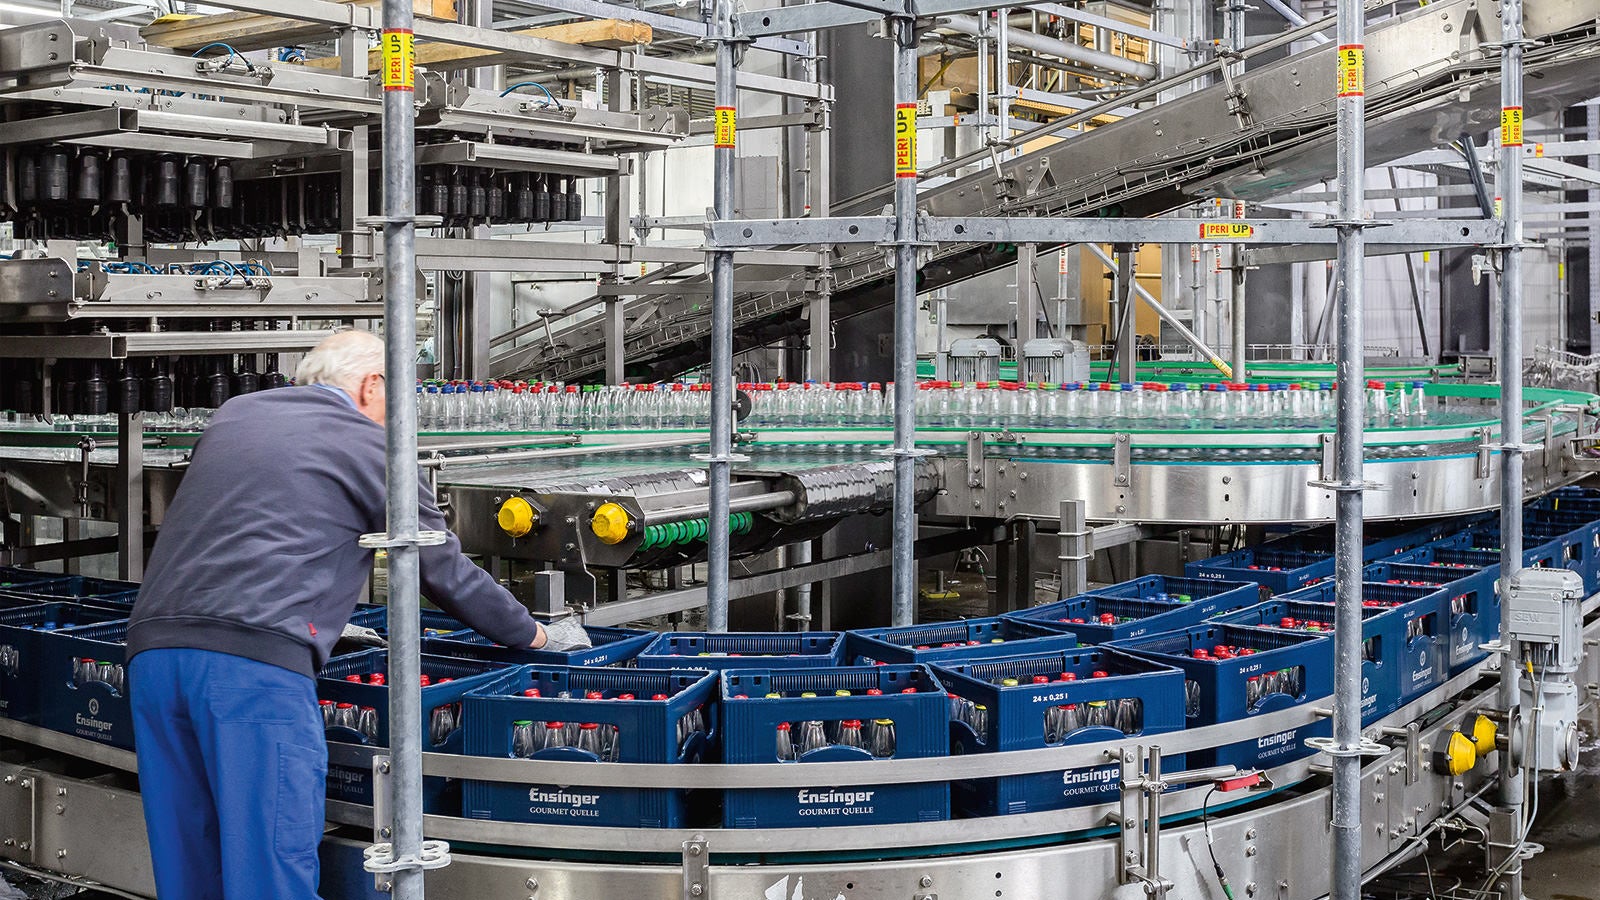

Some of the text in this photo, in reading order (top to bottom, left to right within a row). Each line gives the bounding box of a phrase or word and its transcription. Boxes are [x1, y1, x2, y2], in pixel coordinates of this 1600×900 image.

[391, 34, 401, 80] PERI UP
[1348, 50, 1357, 88] PERI UP
[722, 111, 729, 124] UP
[1513, 110, 1520, 123] UP
[897, 110, 908, 166] PERI UP
[1210, 224, 1249, 234] PERI UP
[1032, 695, 1042, 703] 24
[1049, 693, 1064, 701] 0,25
[75, 712, 113, 732] Ensinger
[1257, 729, 1297, 749] Ensinger
[328, 765, 365, 783] singer
[1062, 768, 1120, 785] Ensinge
[528, 787, 600, 807] Ensinger
[797, 789, 875, 806] Ensinger
[1063, 783, 1120, 797] GOURMET QUEL
[529, 806, 600, 817] GOURMET QUELLE
[798, 806, 874, 816] GOURMET QUELLE
